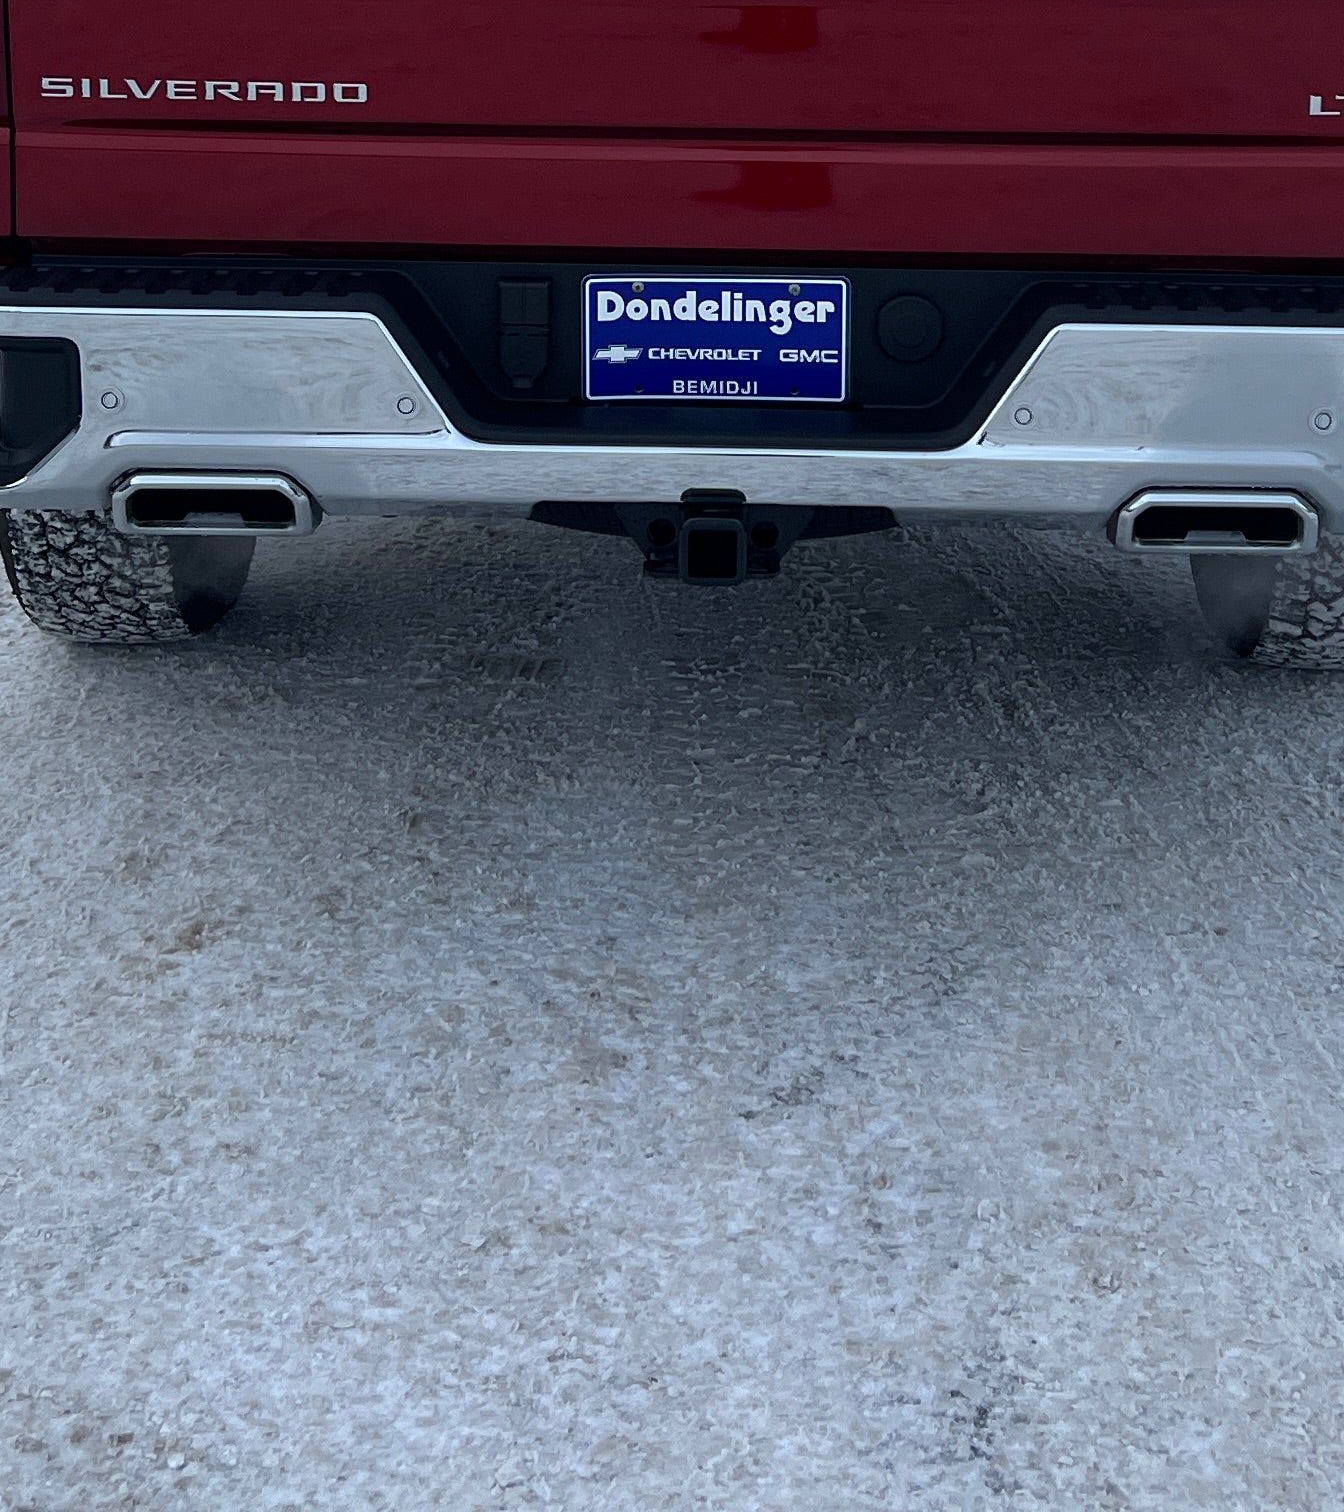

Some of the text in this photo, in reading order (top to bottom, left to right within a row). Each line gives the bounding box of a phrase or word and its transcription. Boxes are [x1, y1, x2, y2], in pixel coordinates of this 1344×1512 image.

[41, 76, 368, 103] SILVERADO
[596, 290, 835, 335] Dondelinger
[648, 348, 839, 363] CHEVROLET GMC
[672, 379, 758, 395] BEMIDJI
